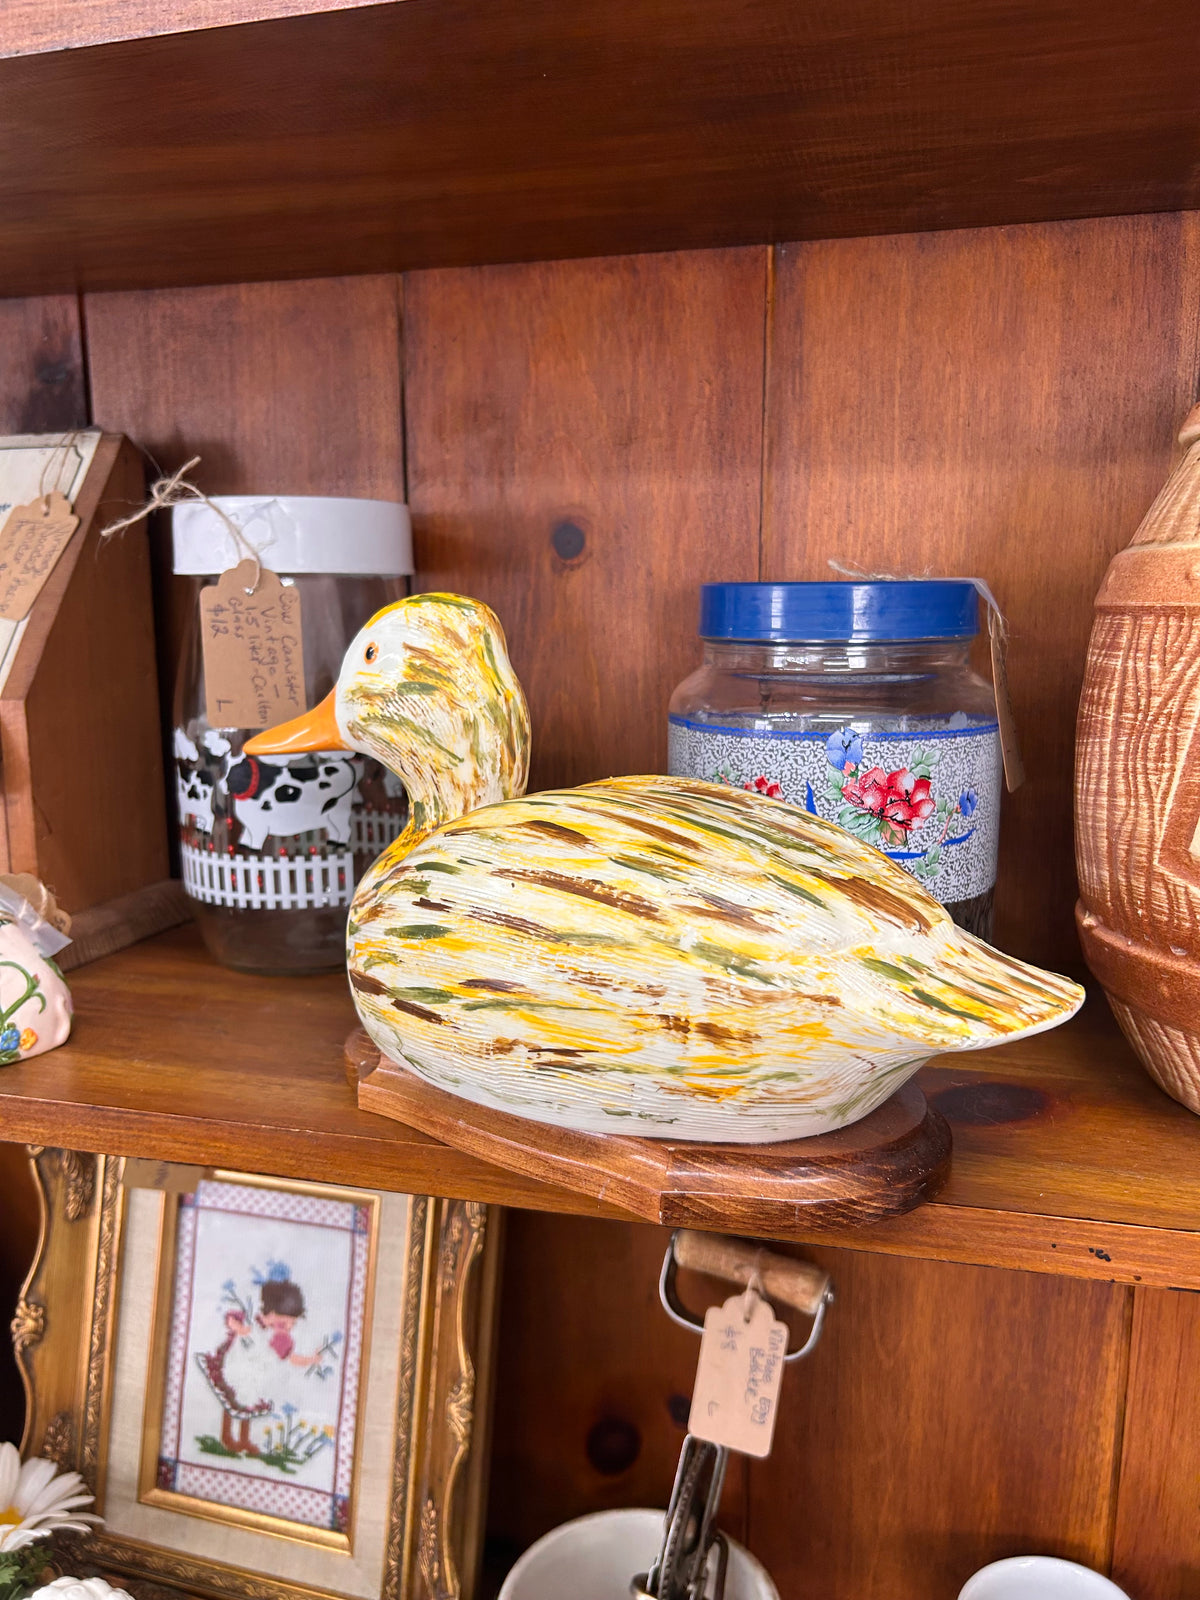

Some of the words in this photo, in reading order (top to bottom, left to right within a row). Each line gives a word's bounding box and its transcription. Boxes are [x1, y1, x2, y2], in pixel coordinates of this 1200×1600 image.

[206, 604, 230, 639] $12
[228, 597, 244, 640] Glass
[245, 607, 260, 628] 1.5
[279, 593, 298, 625] Cow
[260, 606, 280, 675] Vintage
[281, 636, 300, 706] Canister
